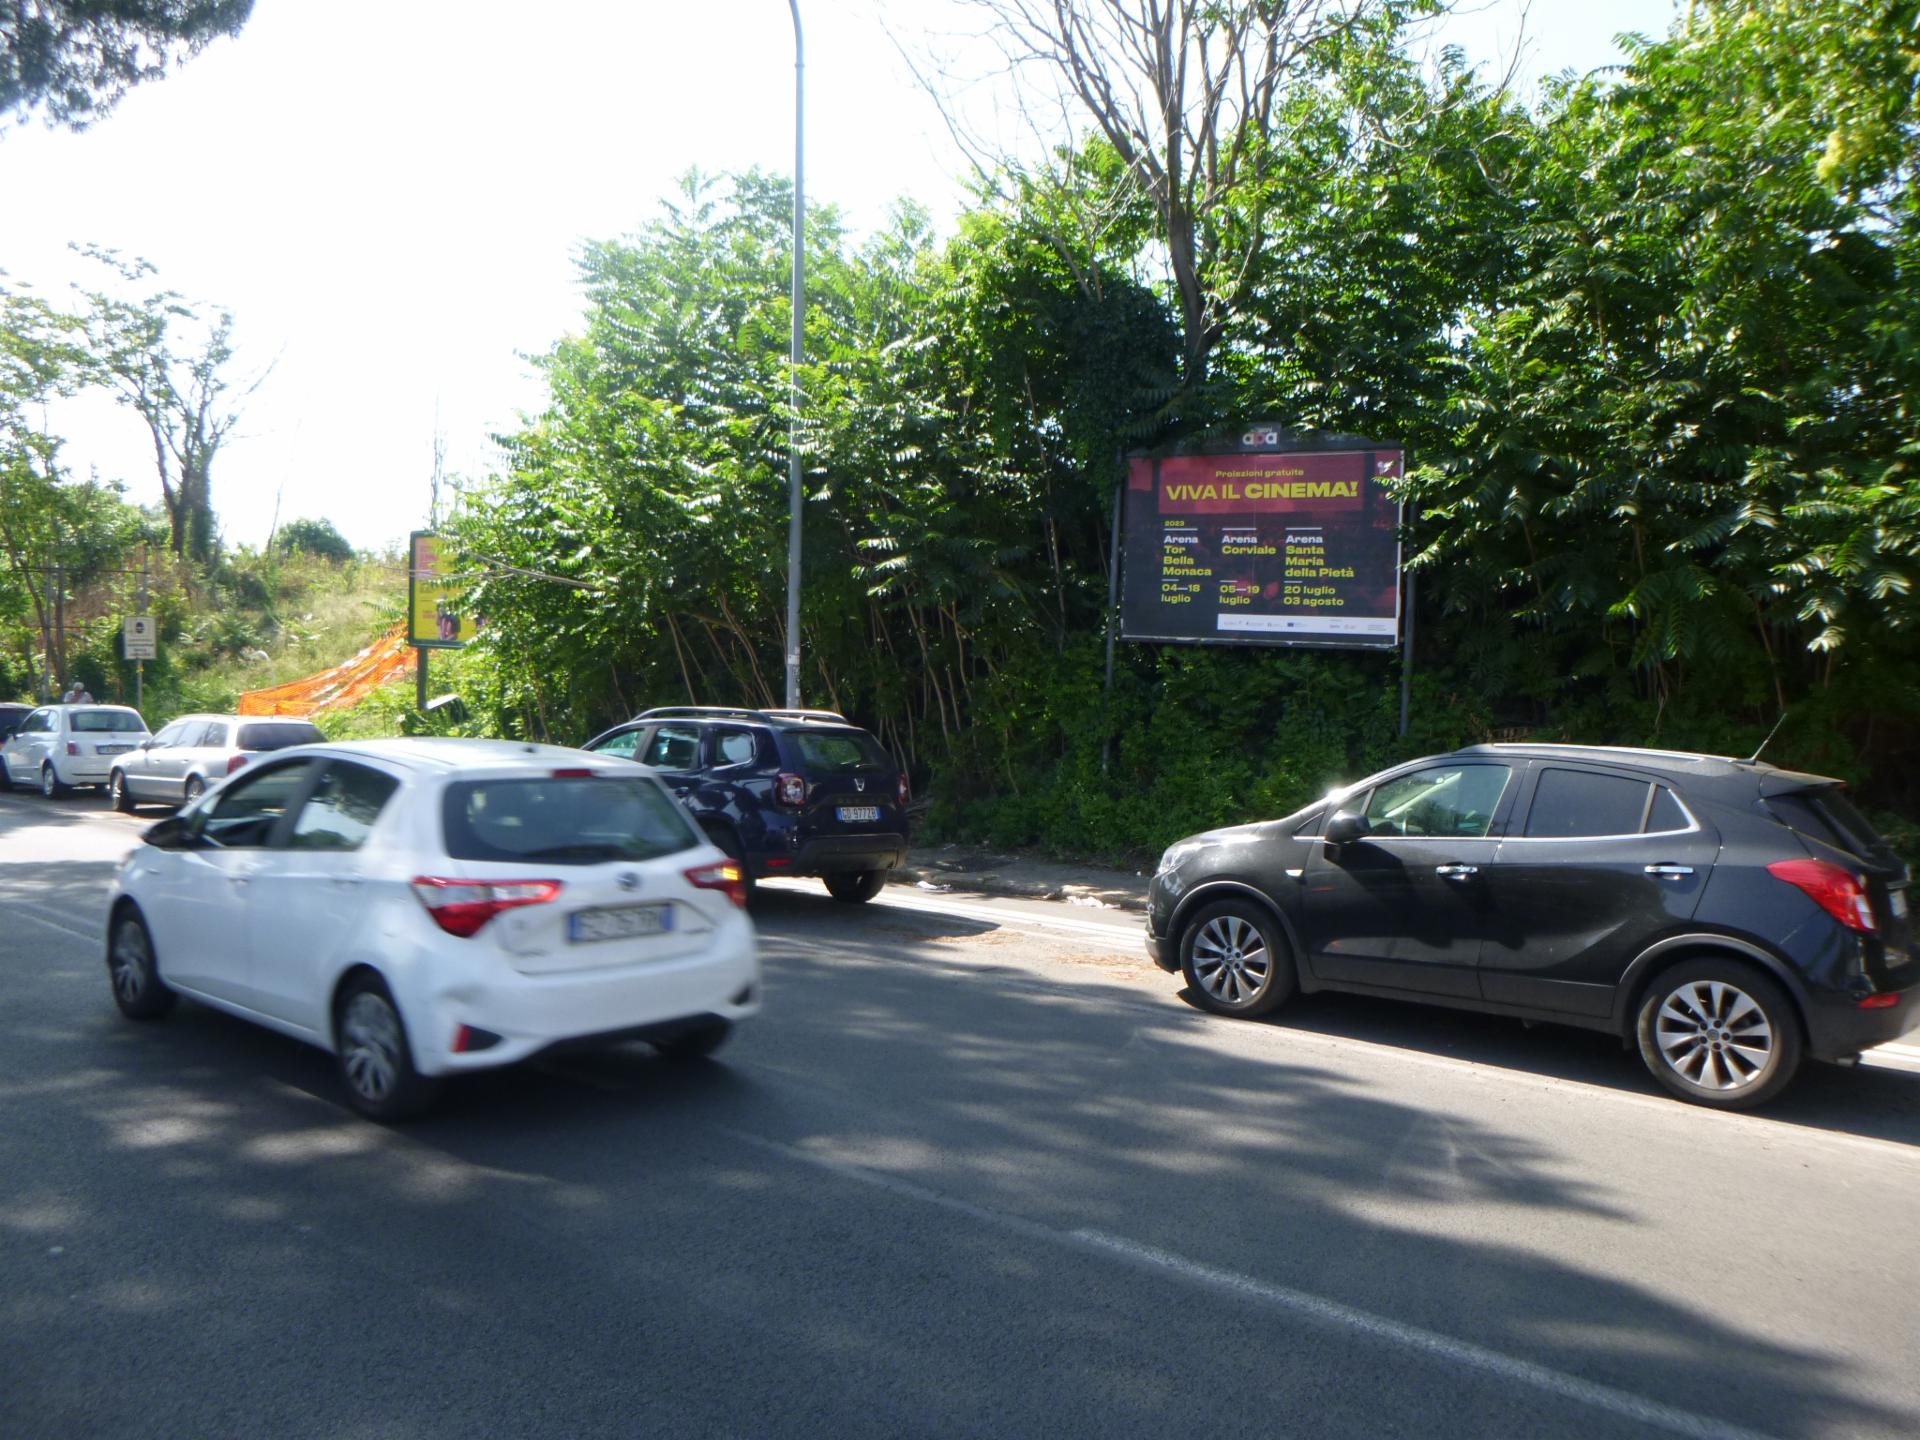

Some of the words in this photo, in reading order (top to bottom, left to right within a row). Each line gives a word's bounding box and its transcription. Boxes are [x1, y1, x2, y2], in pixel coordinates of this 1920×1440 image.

[1166, 485, 1218, 500] VIVA
[1222, 484, 1241, 499] IL
[1244, 481, 1359, 498] CINEMA!
[1163, 535, 1199, 544] Arena
[1221, 535, 1258, 544] Arena
[1285, 535, 1323, 544] Arena
[1164, 545, 1186, 555] Tor
[1221, 545, 1277, 555] Corviale
[1285, 545, 1325, 555] Santa
[1163, 556, 1194, 566] Bella
[1285, 556, 1325, 567] Maria
[1162, 566, 1212, 577] Monaca
[1285, 568, 1317, 578] della
[1319, 567, 1354, 578] Pietà
[1284, 585, 1301, 595] 20
[1303, 585, 1336, 597] luglio
[1161, 593, 1191, 604] luglio
[1219, 595, 1251, 606] luglio
[1283, 597, 1301, 606] 03
[1302, 597, 1344, 608] agosto
